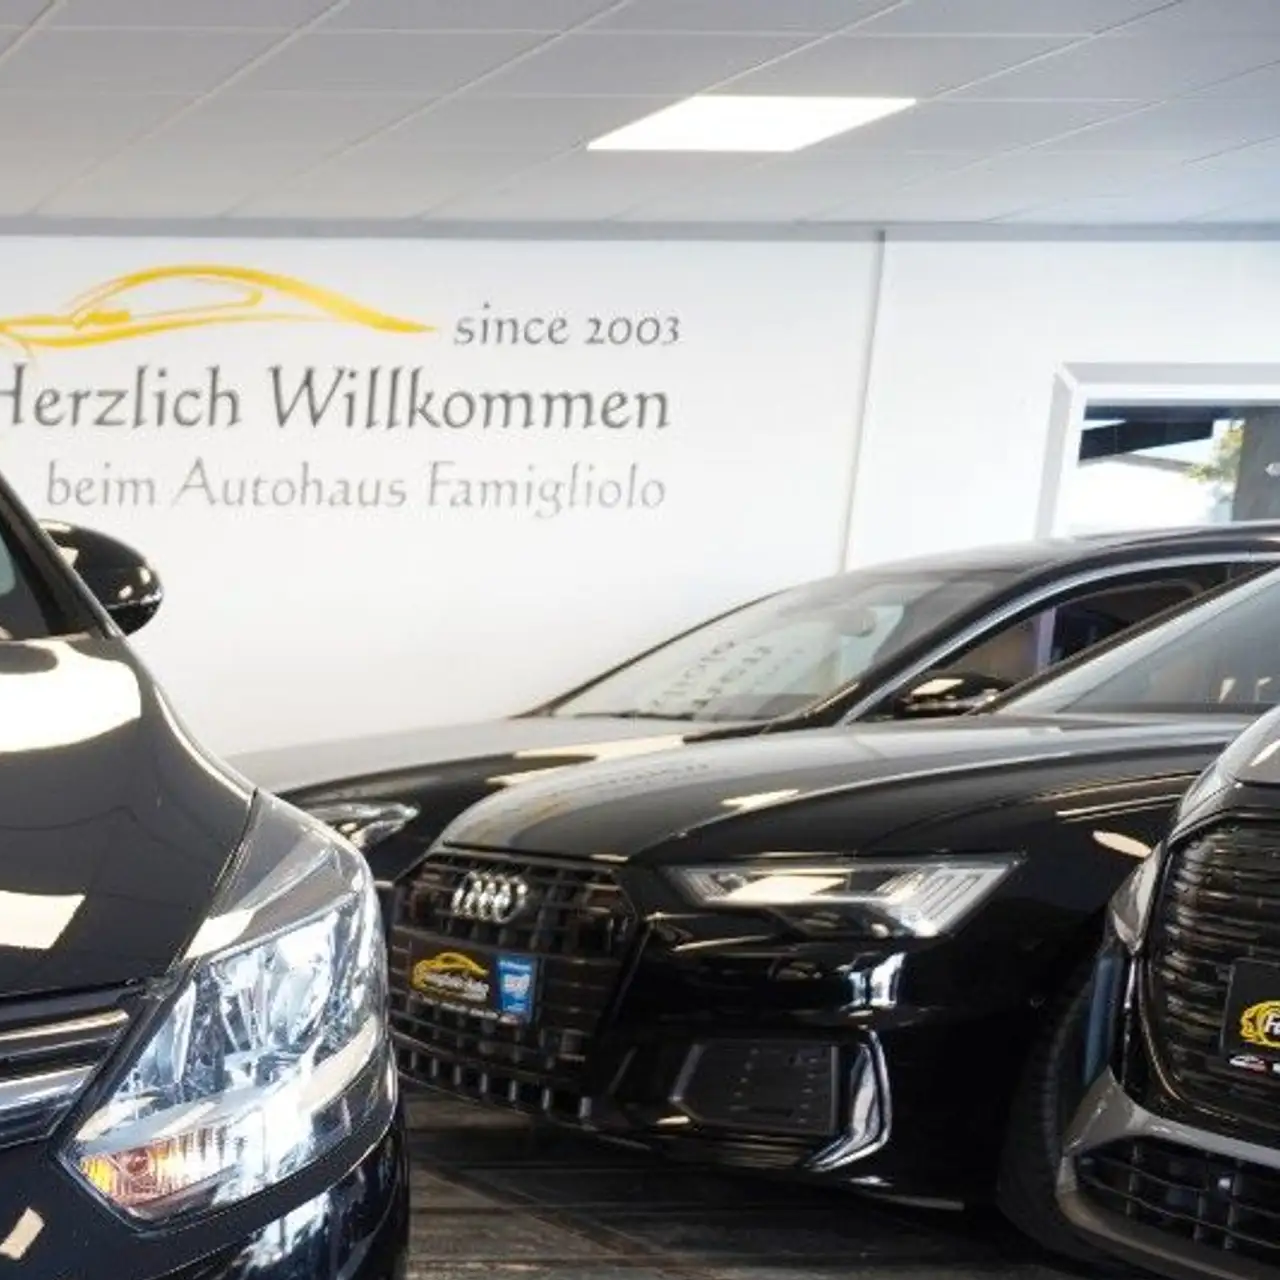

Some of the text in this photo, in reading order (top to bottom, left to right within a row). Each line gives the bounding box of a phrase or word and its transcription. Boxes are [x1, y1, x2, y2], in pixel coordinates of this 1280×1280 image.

[453, 302, 682, 346] since 2003
[268, 364, 673, 430] Willkommen
[46, 456, 667, 519] beim Autohaus Famigliolo
